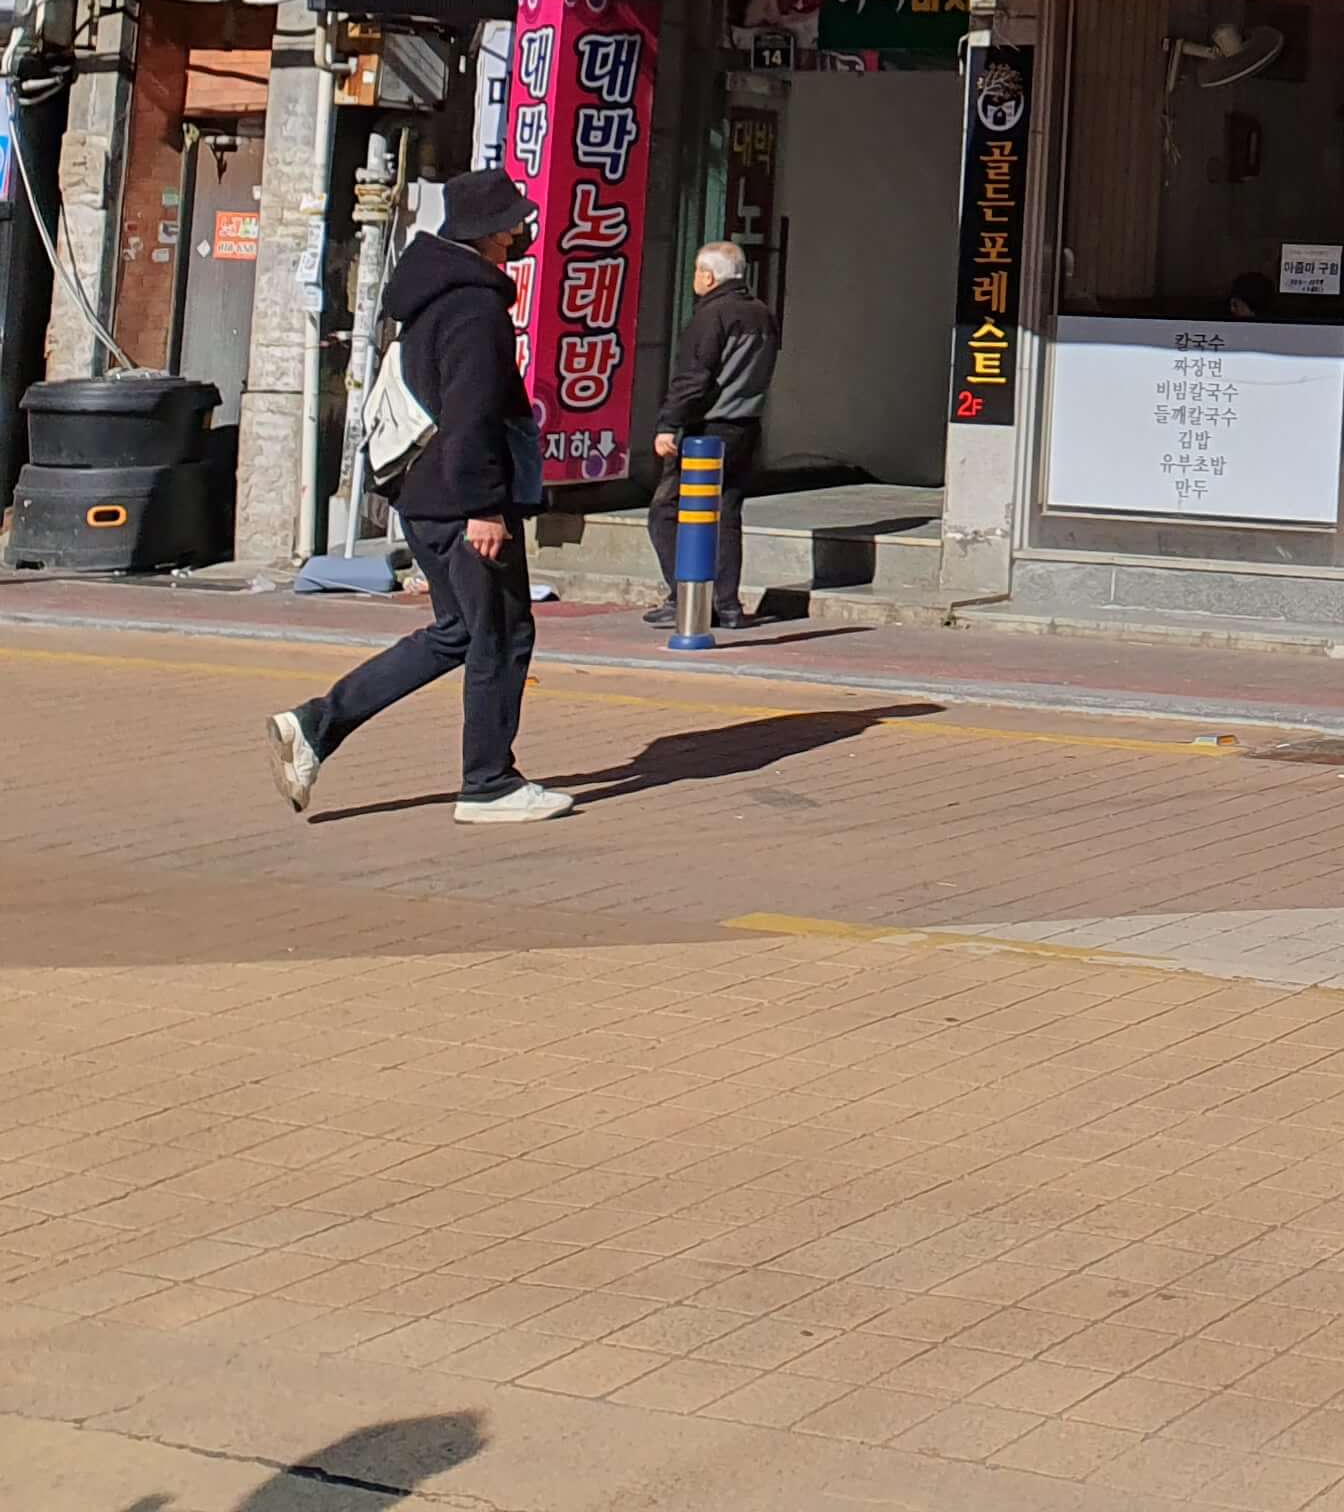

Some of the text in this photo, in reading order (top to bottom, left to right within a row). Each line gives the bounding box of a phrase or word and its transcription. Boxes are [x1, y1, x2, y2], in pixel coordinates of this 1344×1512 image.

[762, 49, 783, 66] 14
[516, 25, 556, 178] 대박
[555, 32, 643, 414] 대박 노래방
[966, 141, 1019, 385] 골든포레스트
[1175, 332, 1225, 352] 칼국수
[1174, 357, 1223, 378] 짜장면
[1156, 380, 1239, 403] 비빔칼국수
[957, 391, 984, 418] 2F
[1154, 404, 1238, 428] 들깨칼국수
[545, 431, 591, 461] 지하
[1178, 430, 1212, 451] 김밥
[1160, 453, 1226, 476] 유부초밥
[1175, 478, 1209, 500] 만두
